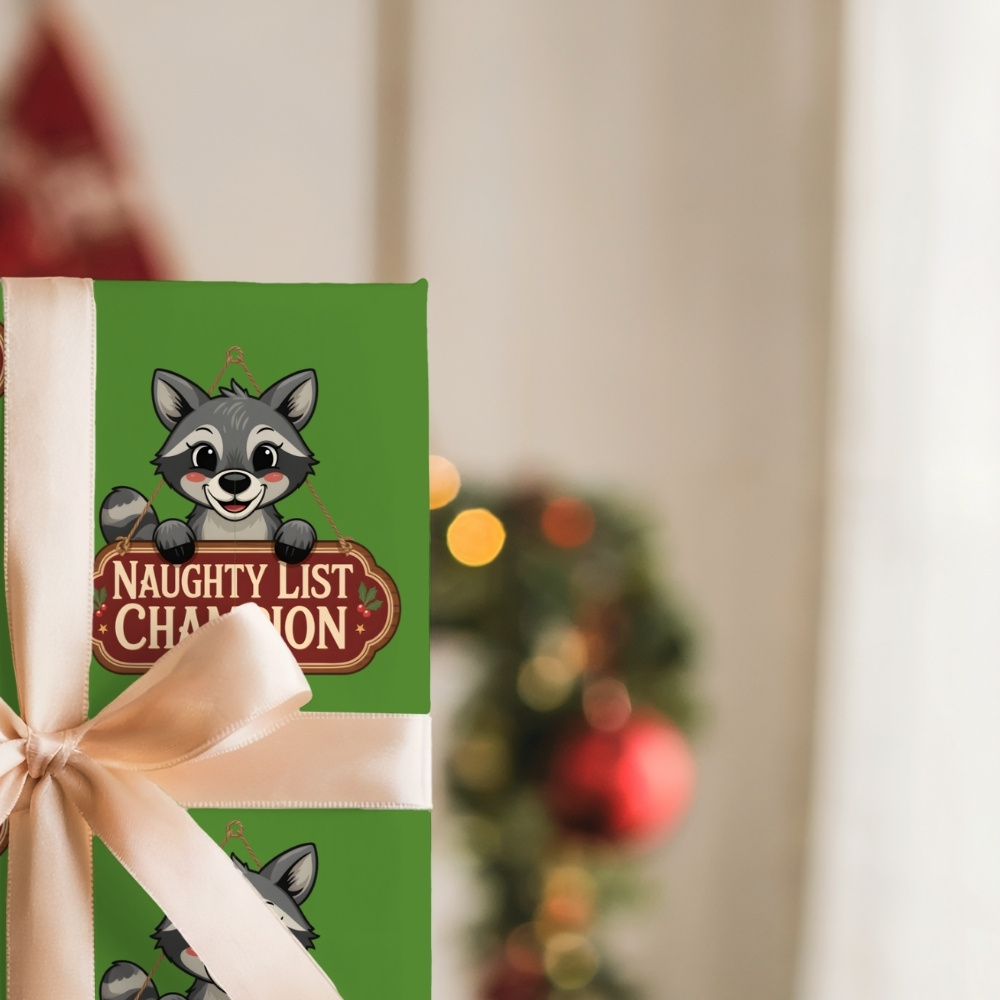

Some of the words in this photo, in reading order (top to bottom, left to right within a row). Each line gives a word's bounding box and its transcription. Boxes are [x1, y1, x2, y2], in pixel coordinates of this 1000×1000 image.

[112, 560, 268, 600] NAUGHTY
[277, 560, 354, 600] LIST
[114, 603, 348, 650] CHAION
